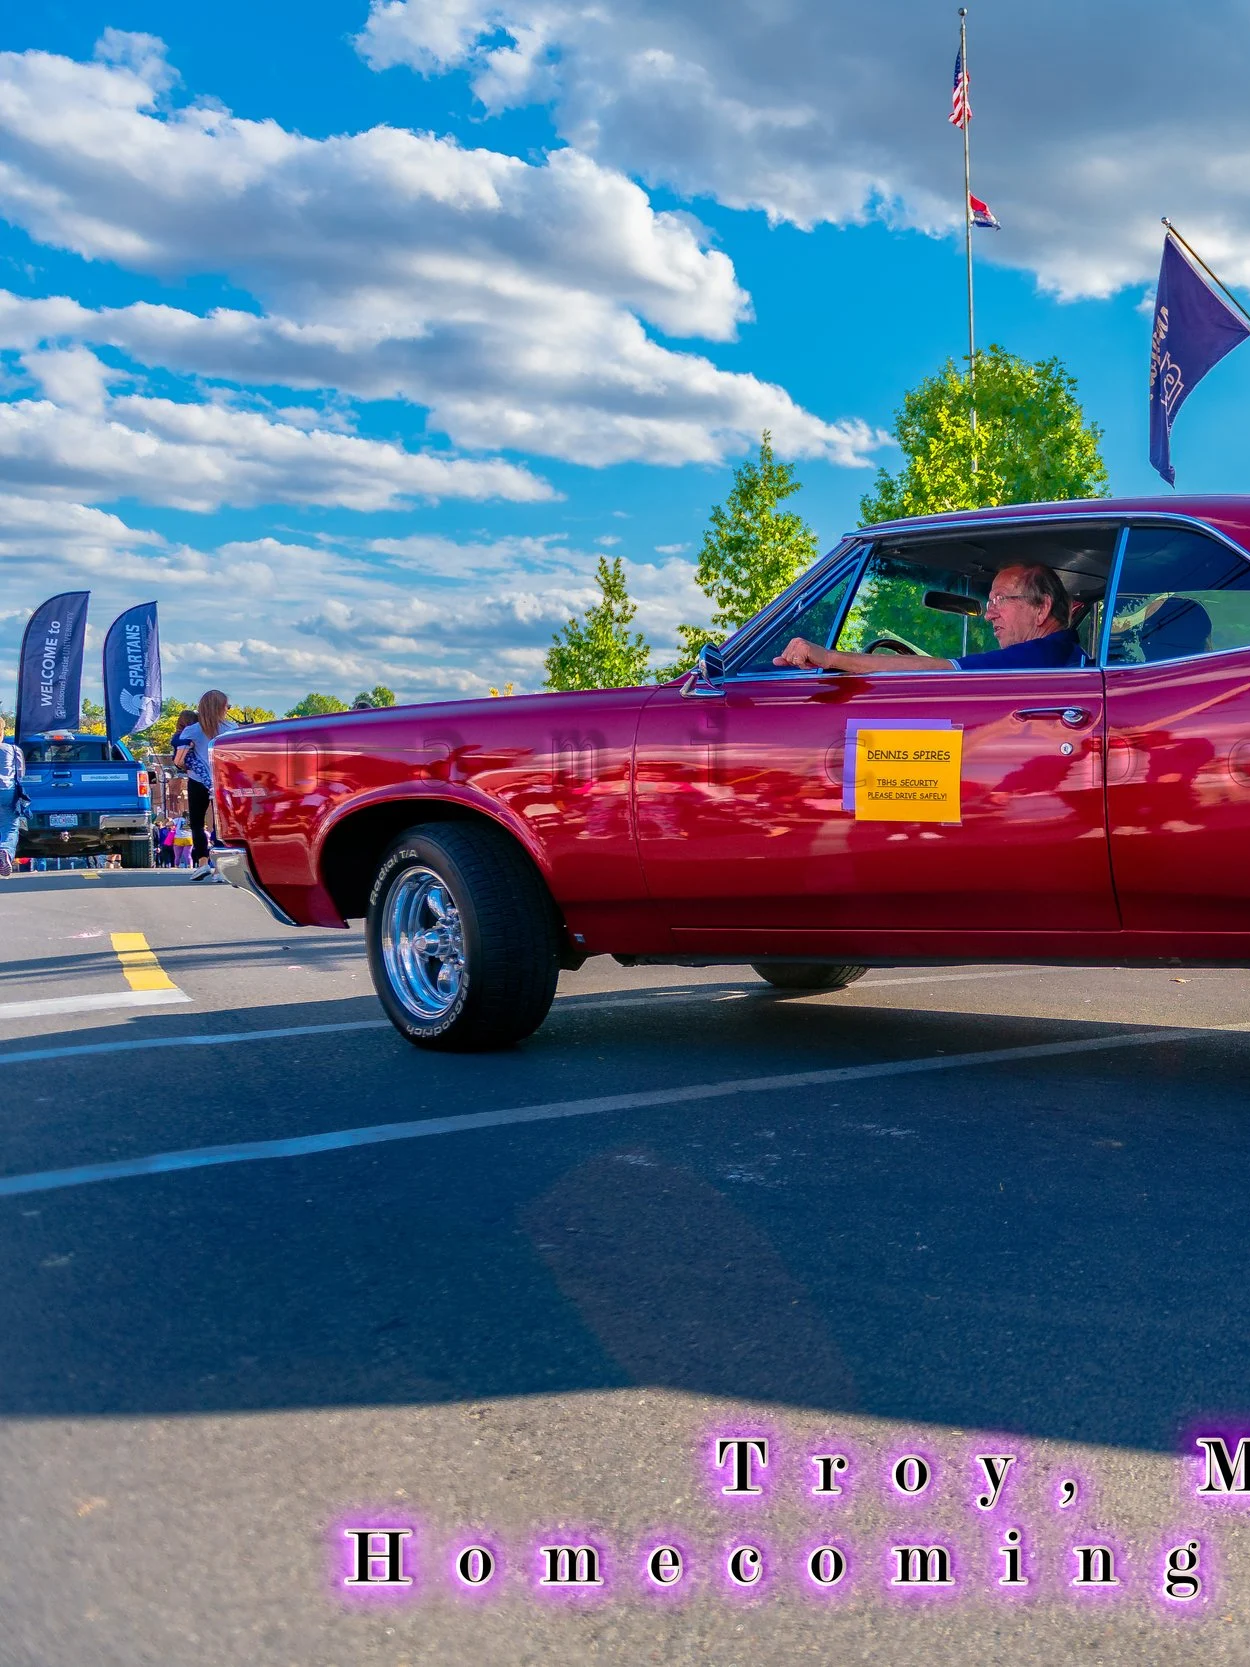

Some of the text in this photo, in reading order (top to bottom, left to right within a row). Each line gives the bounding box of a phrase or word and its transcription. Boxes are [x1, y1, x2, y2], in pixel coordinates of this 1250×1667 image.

[41, 621, 61, 707] WELCOME to
[125, 624, 145, 687] SPARTANS
[867, 750, 951, 760] DENNIS SPIRES
[900, 779, 938, 787] SECURITY
[896, 792, 917, 800] DRIVE
[920, 792, 947, 800] SAFELY!
[369, 849, 419, 906] Radial T/A
[406, 971, 470, 1039] BFGoodrich
